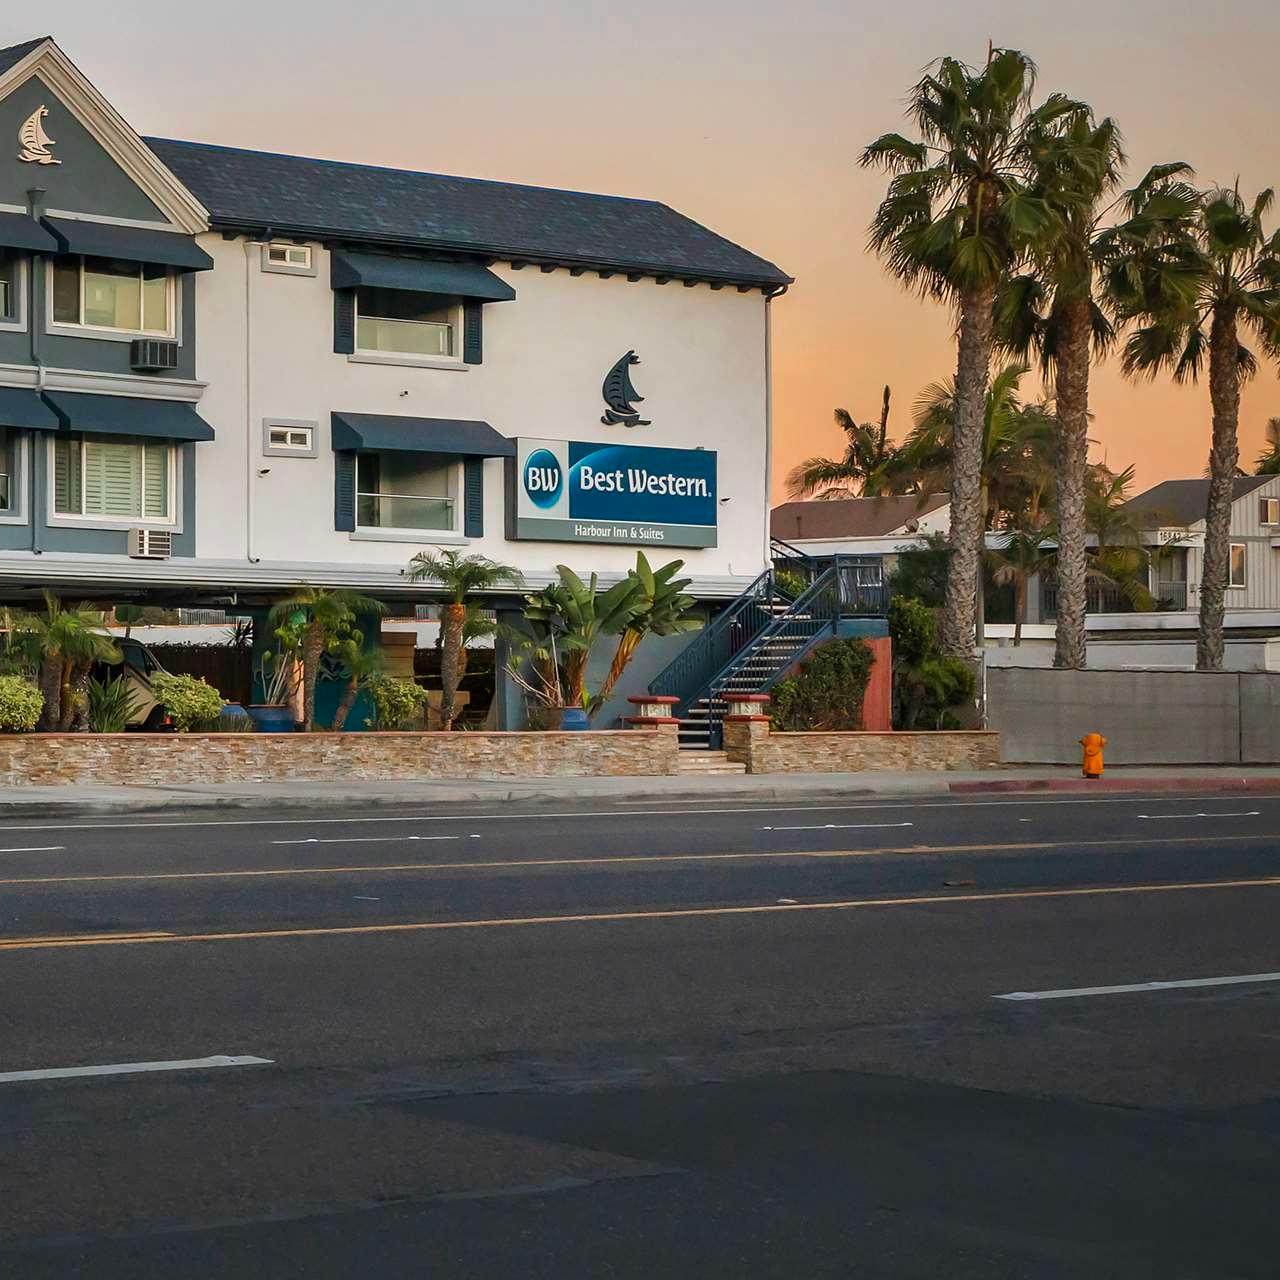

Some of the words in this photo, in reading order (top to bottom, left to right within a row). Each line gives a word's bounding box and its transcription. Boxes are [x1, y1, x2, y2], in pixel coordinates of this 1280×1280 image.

[527, 466, 559, 493] BW
[579, 465, 625, 493] Best
[574, 524, 612, 538] Harbour
[613, 526, 628, 539] Inn
[630, 528, 638, 539] &
[639, 528, 664, 540] Suites
